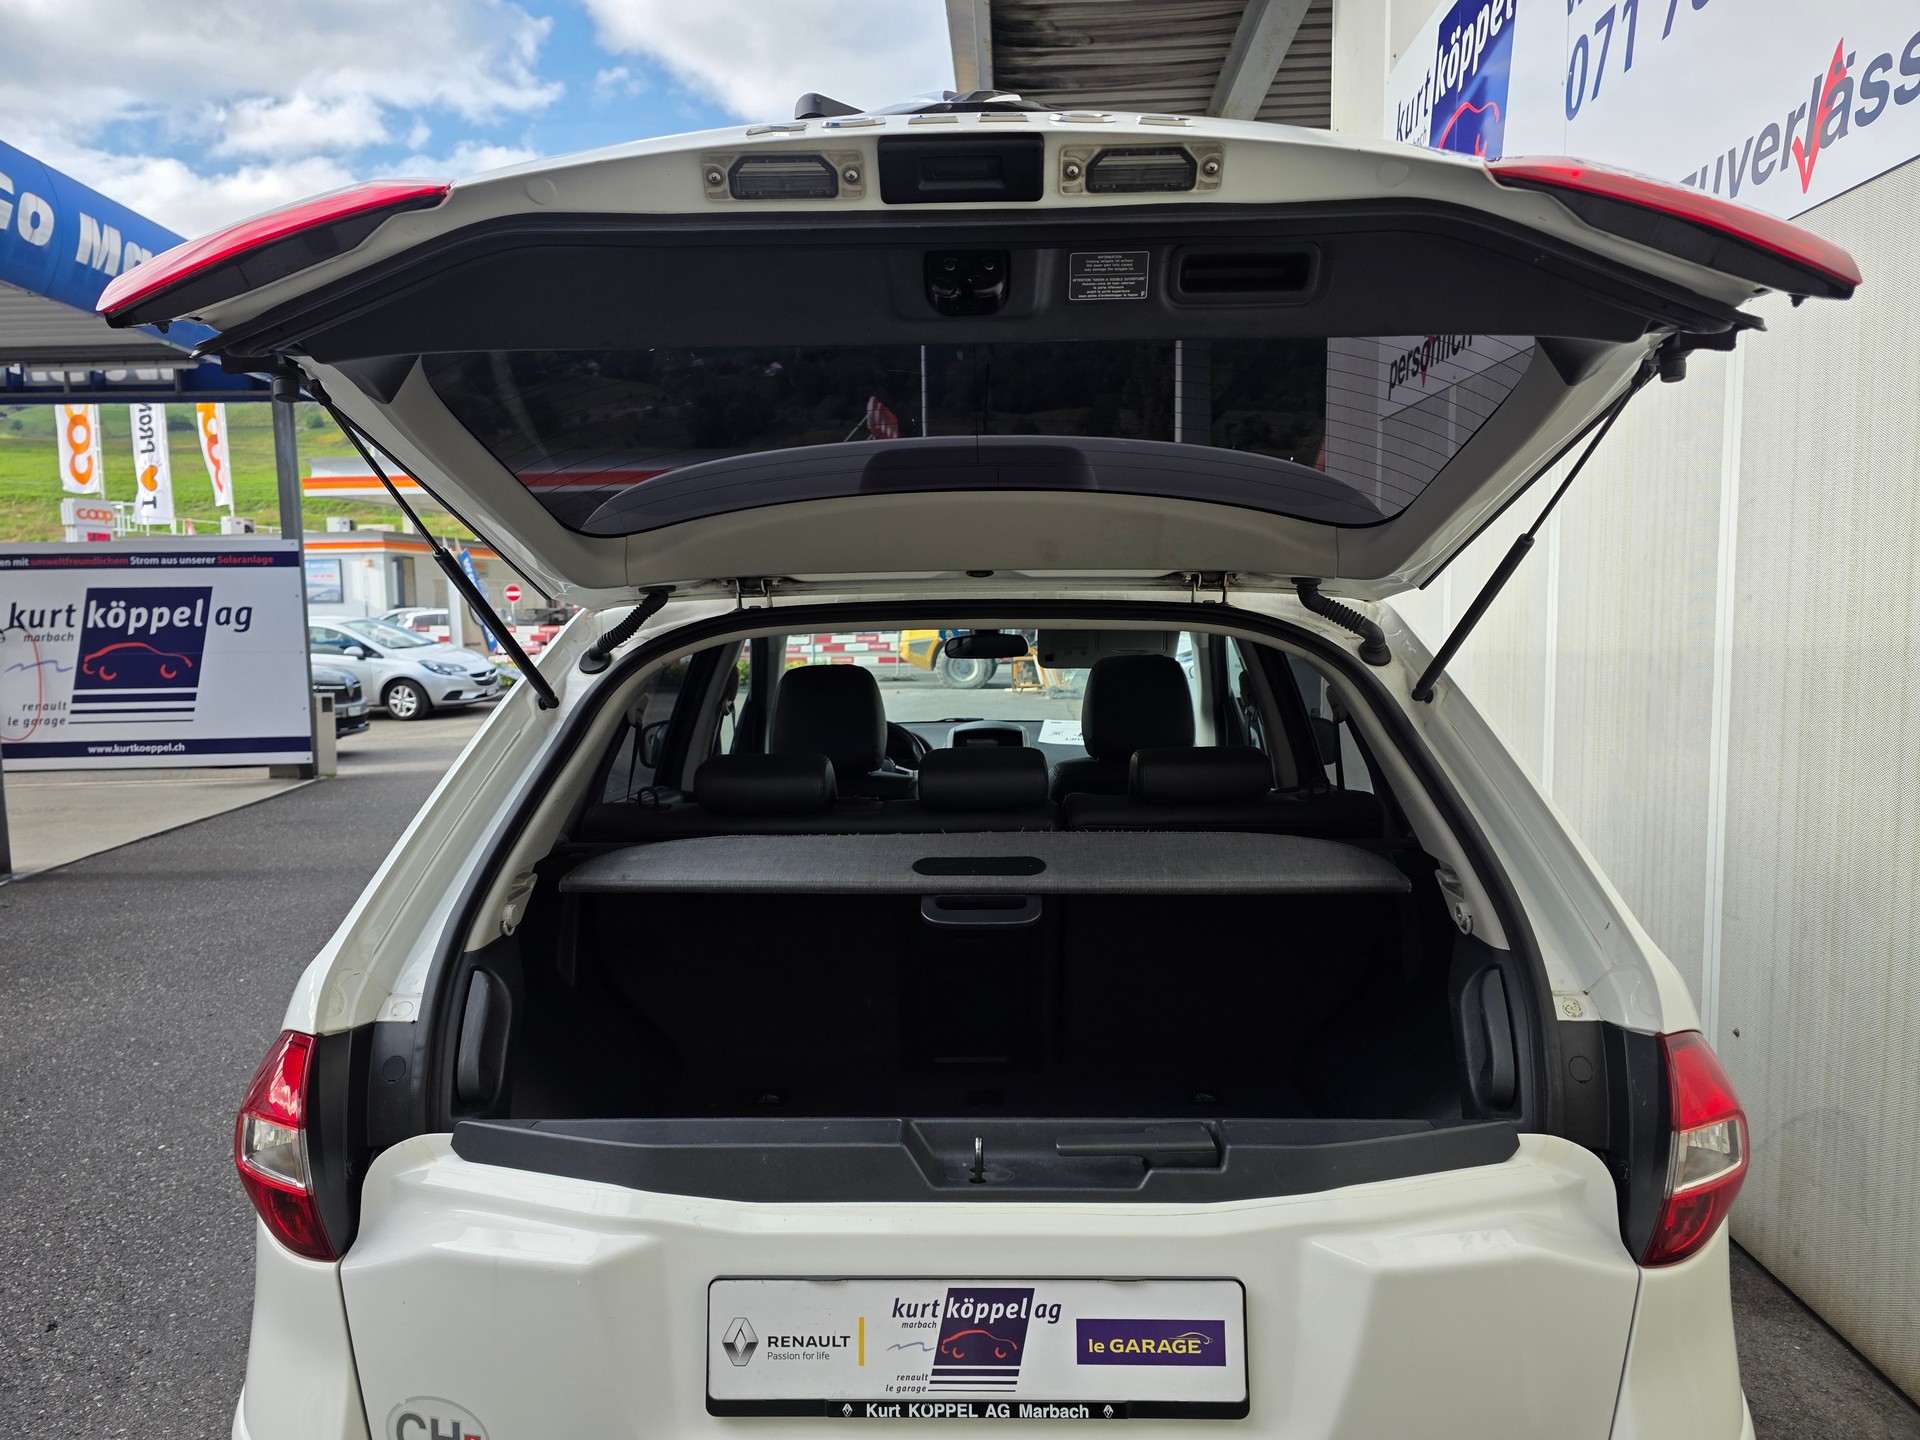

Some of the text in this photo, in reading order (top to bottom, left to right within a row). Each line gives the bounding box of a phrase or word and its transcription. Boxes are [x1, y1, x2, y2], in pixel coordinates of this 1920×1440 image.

[1396, 68, 1431, 142] kurt
[76, 508, 113, 524] coop
[13, 557, 29, 567] mit
[31, 556, 128, 566] umweltfreundlichem
[130, 556, 159, 566] Strom
[161, 557, 178, 565] aus
[179, 557, 215, 565] unserer
[217, 555, 274, 566] Solaranlage
[9, 599, 253, 635] kurt köppel ag
[24, 633, 74, 643] marbach
[22, 702, 67, 712] renault
[8, 716, 66, 728] le garage
[88, 744, 185, 755] www.kurtkoeppel.ch
[892, 1297, 1062, 1325] kurt köppel ag
[901, 1320, 937, 1329] marbach
[767, 1335, 851, 1348] RENAULT
[1088, 1338, 1202, 1354] le GARAGE
[767, 1351, 830, 1360] Passion for life
[896, 1373, 928, 1381] renault
[885, 1384, 927, 1394] le garage
[866, 1402, 1089, 1419] Kurt KÖPPEL AG Marbach
